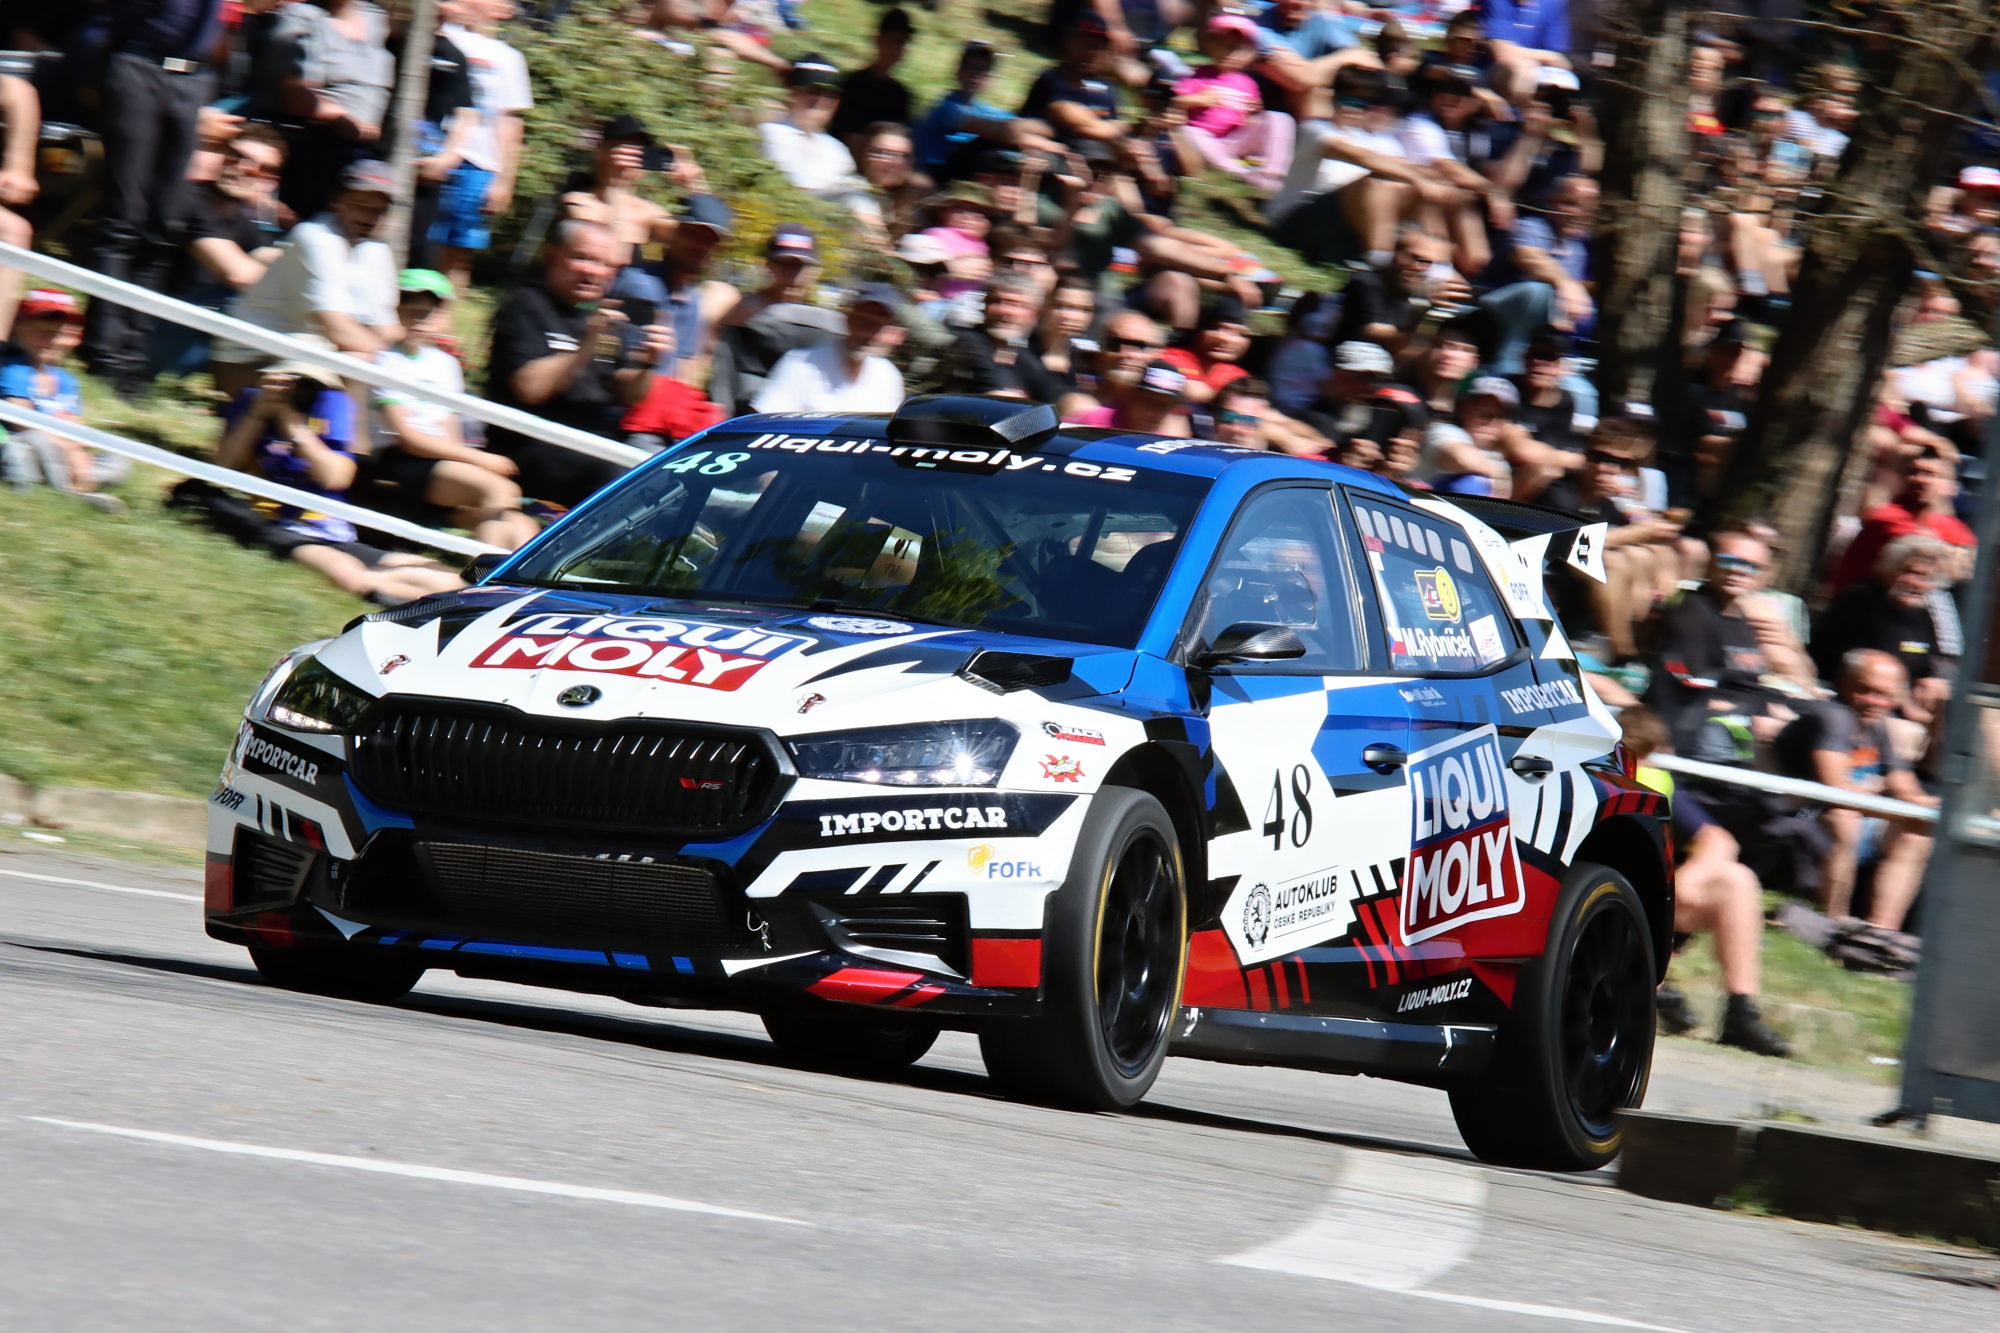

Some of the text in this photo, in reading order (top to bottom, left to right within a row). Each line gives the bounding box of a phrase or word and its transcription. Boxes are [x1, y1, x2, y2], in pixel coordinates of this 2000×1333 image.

[662, 450, 751, 475] 48
[747, 433, 1137, 482] liqui-moly.cz
[525, 616, 798, 656] LIQUI
[483, 637, 768, 685] MOLY
[1501, 679, 1584, 714] IMPORTCAR
[214, 787, 245, 811] FOFR
[1263, 763, 1313, 852] 48
[1412, 742, 1505, 842] LIQUI
[818, 806, 1008, 837] IMPORTCAR
[1274, 875, 1338, 912] AUTOKLUB
[1409, 825, 1511, 927] MOLY
[1273, 900, 1336, 930] ČESKÉ REPUBLIKY
[1396, 978, 1473, 1013] LIQUI-MOLY.CZ
